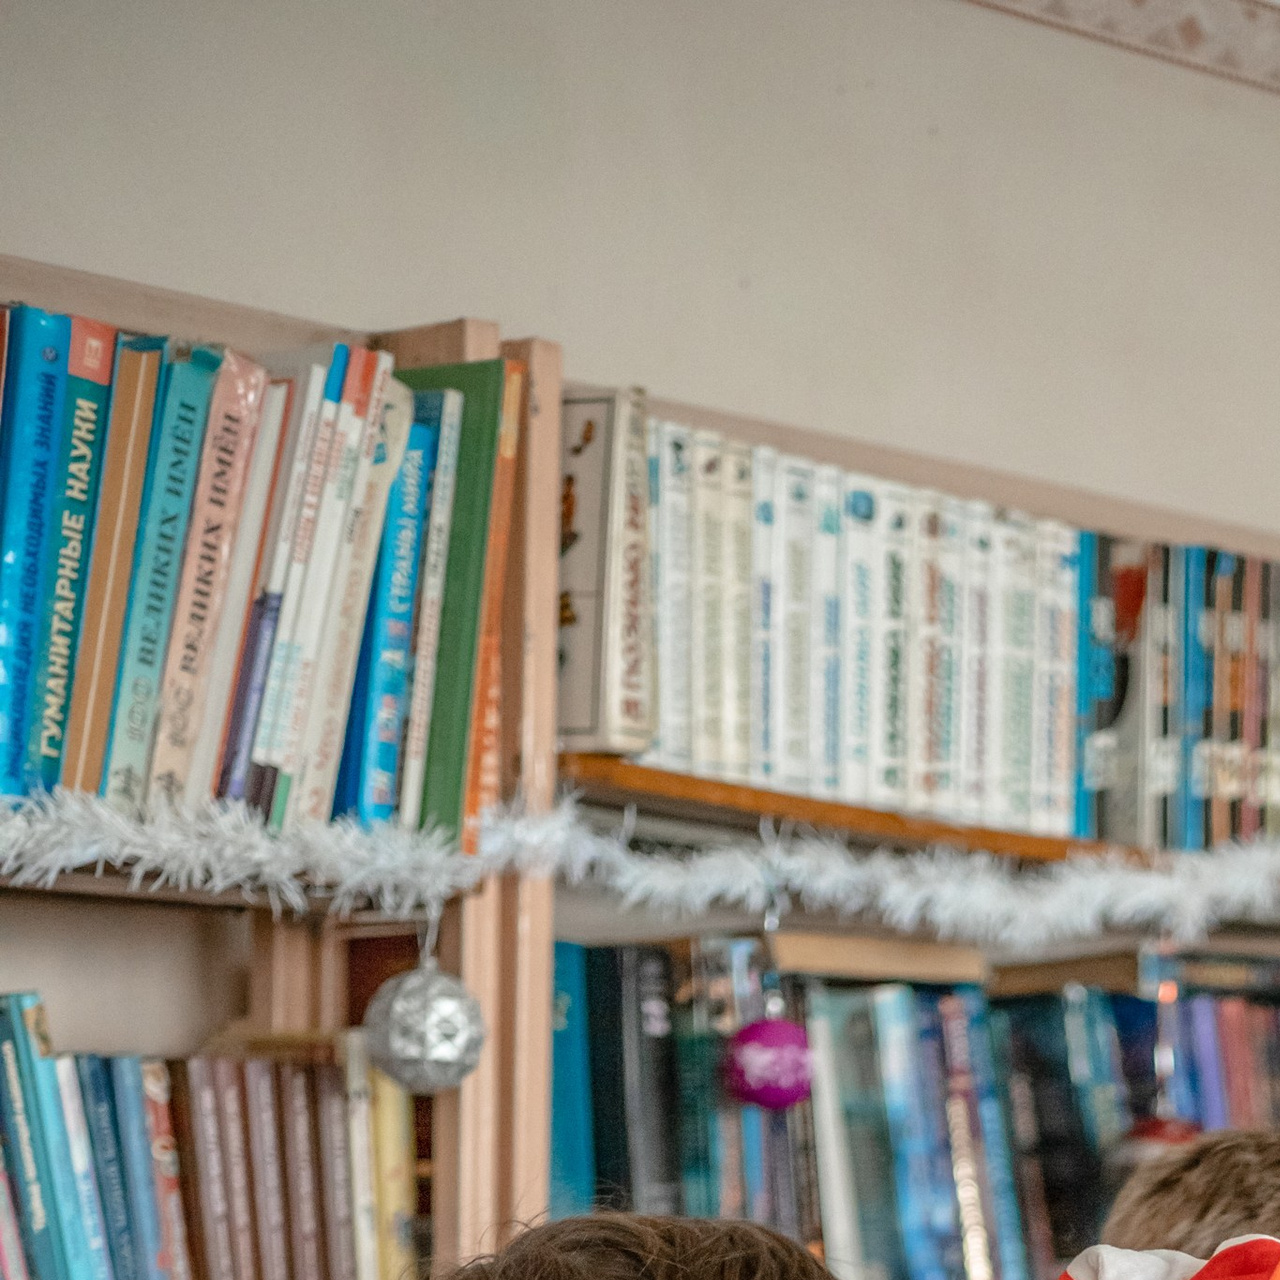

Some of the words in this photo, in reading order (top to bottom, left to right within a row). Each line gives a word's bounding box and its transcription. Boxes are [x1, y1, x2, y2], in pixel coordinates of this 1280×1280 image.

[22, 459, 49, 616] НЕОБХОДИМЫХ
[35, 372, 56, 450] ЗНАНИЙ
[138, 509, 180, 668] ВЕЛИКИХ
[167, 400, 197, 498] ИМЁН
[180, 518, 224, 675] ВЕЛИКИХ
[210, 411, 240, 508] ИМЁН
[40, 509, 85, 758] ГУМАНИТАРНЫЕ
[65, 397, 99, 501] НАУКИ
